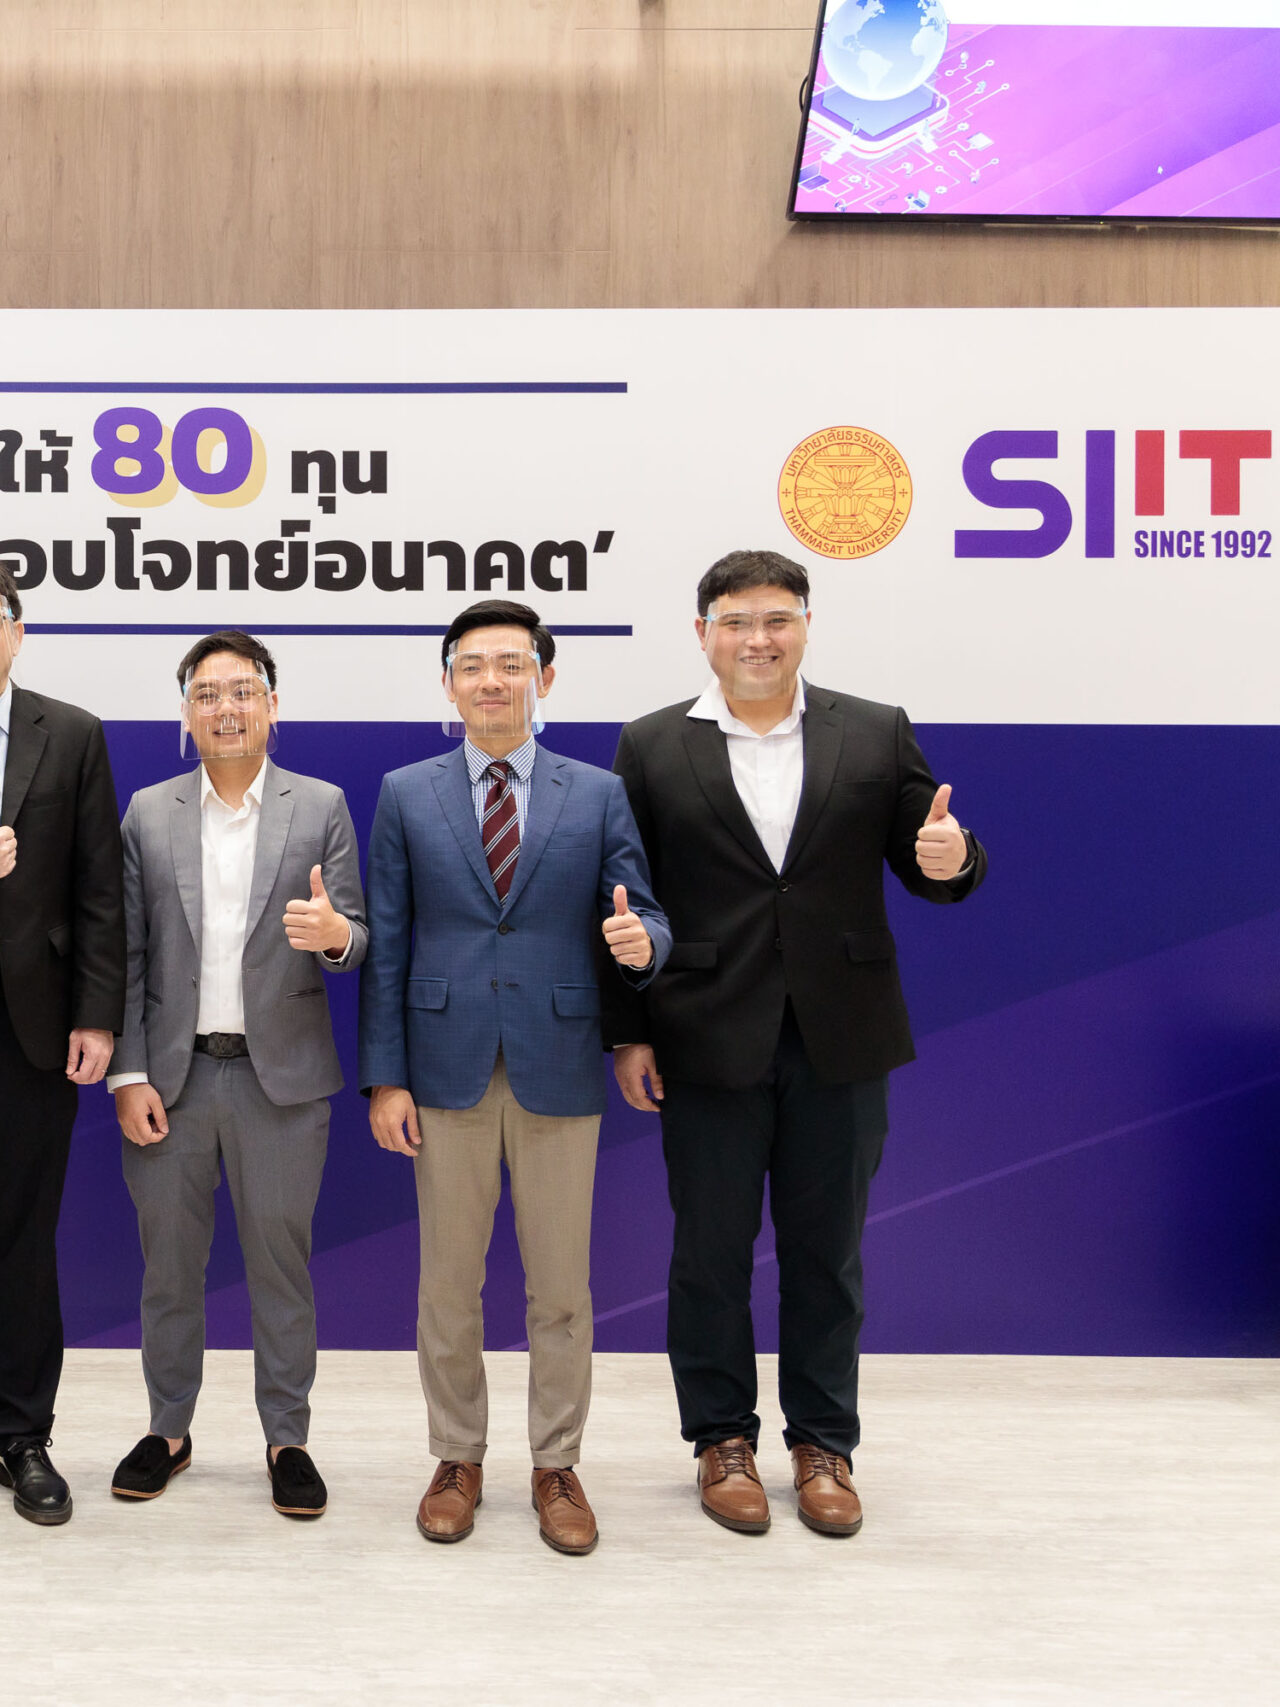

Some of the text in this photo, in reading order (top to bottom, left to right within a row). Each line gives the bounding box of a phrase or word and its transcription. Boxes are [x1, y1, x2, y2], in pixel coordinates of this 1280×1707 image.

[91, 406, 253, 494] 80
[291, 449, 388, 514] ทุน
[785, 429, 908, 479] มหาวิทยาลัยธรรมศาสตร์
[954, 429, 1272, 559] SIIT
[785, 507, 905, 555] THAMMASAT UNIVERSITY
[1134, 530, 1272, 559] SINCE 1992
